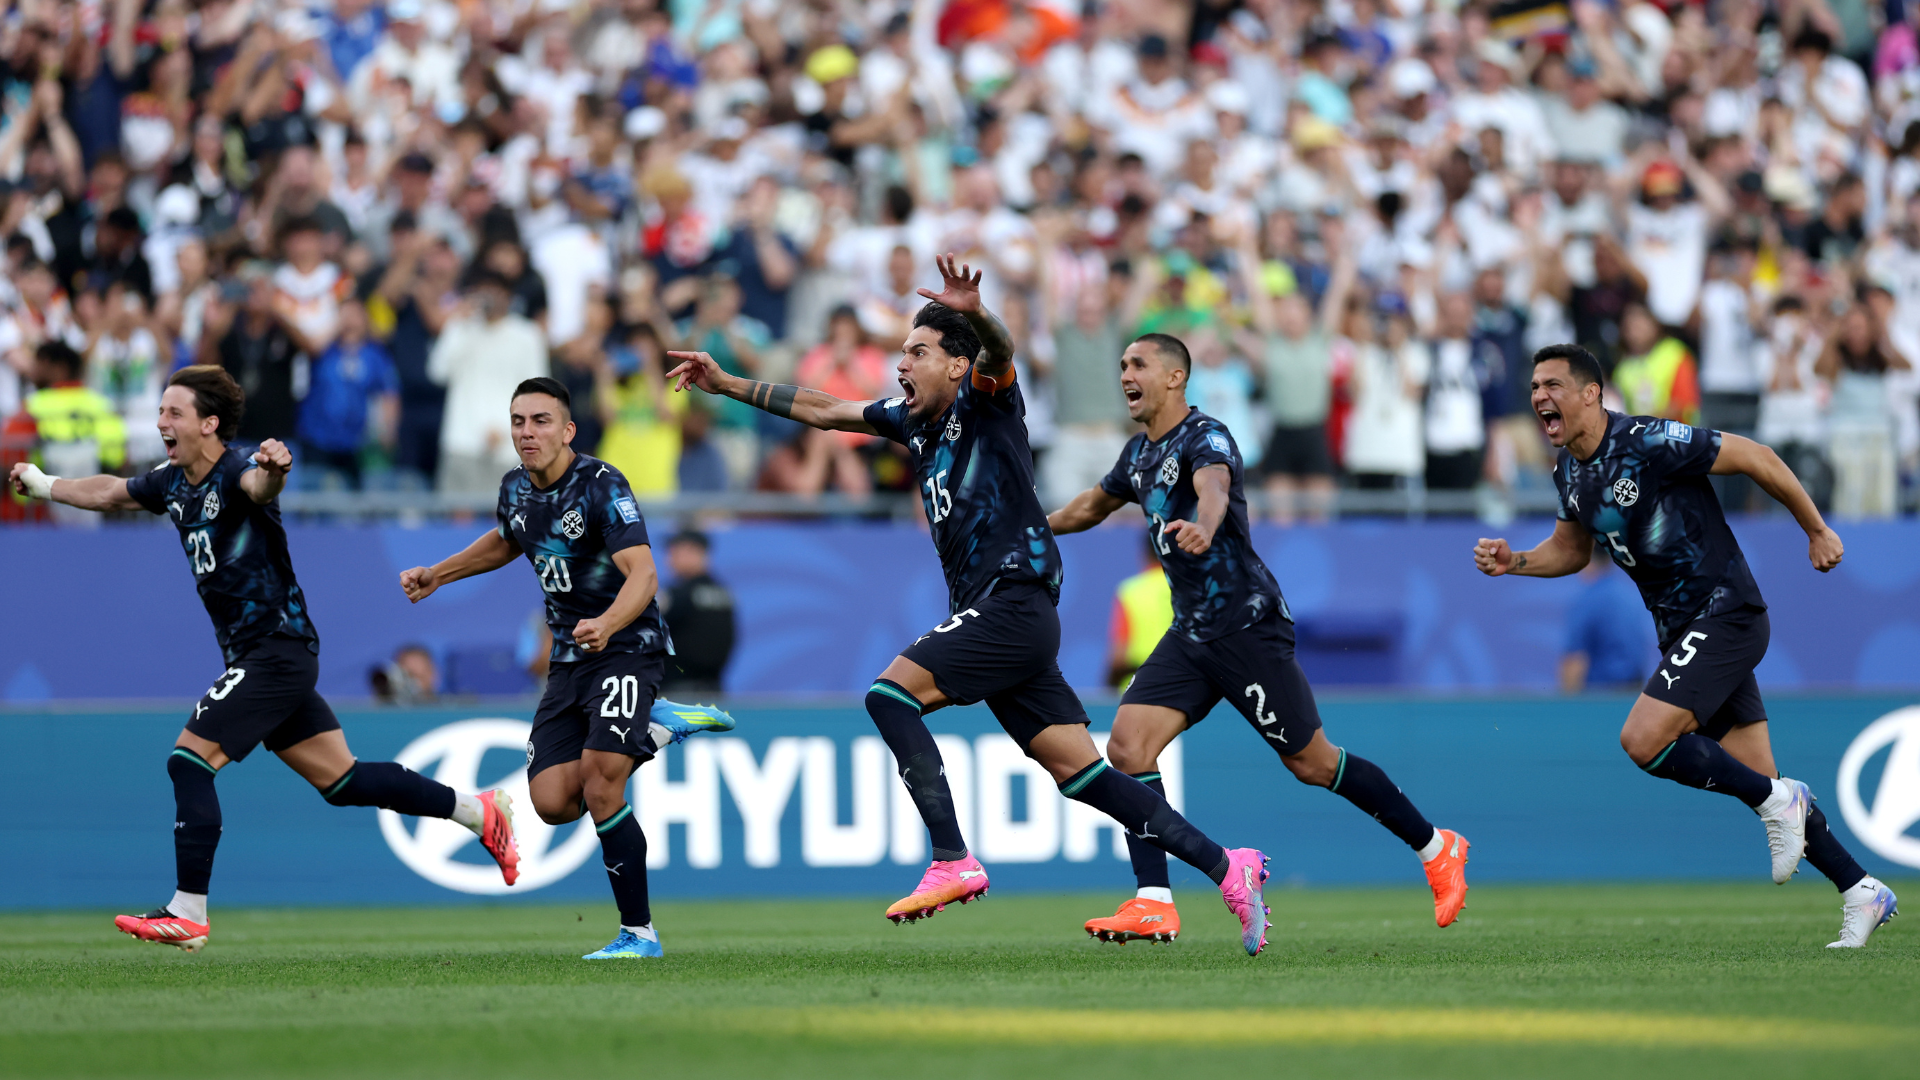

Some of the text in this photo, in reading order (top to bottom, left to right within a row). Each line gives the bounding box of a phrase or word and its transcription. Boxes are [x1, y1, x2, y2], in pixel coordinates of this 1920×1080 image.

[926, 469, 952, 523] 15
[188, 530, 216, 574] 23
[1153, 512, 1171, 556] 2
[1606, 530, 1636, 567] 5
[534, 555, 573, 592] 20
[1670, 631, 1708, 667] 5
[206, 667, 246, 701] 3
[600, 674, 639, 719] 20
[1245, 682, 1277, 726] 2
